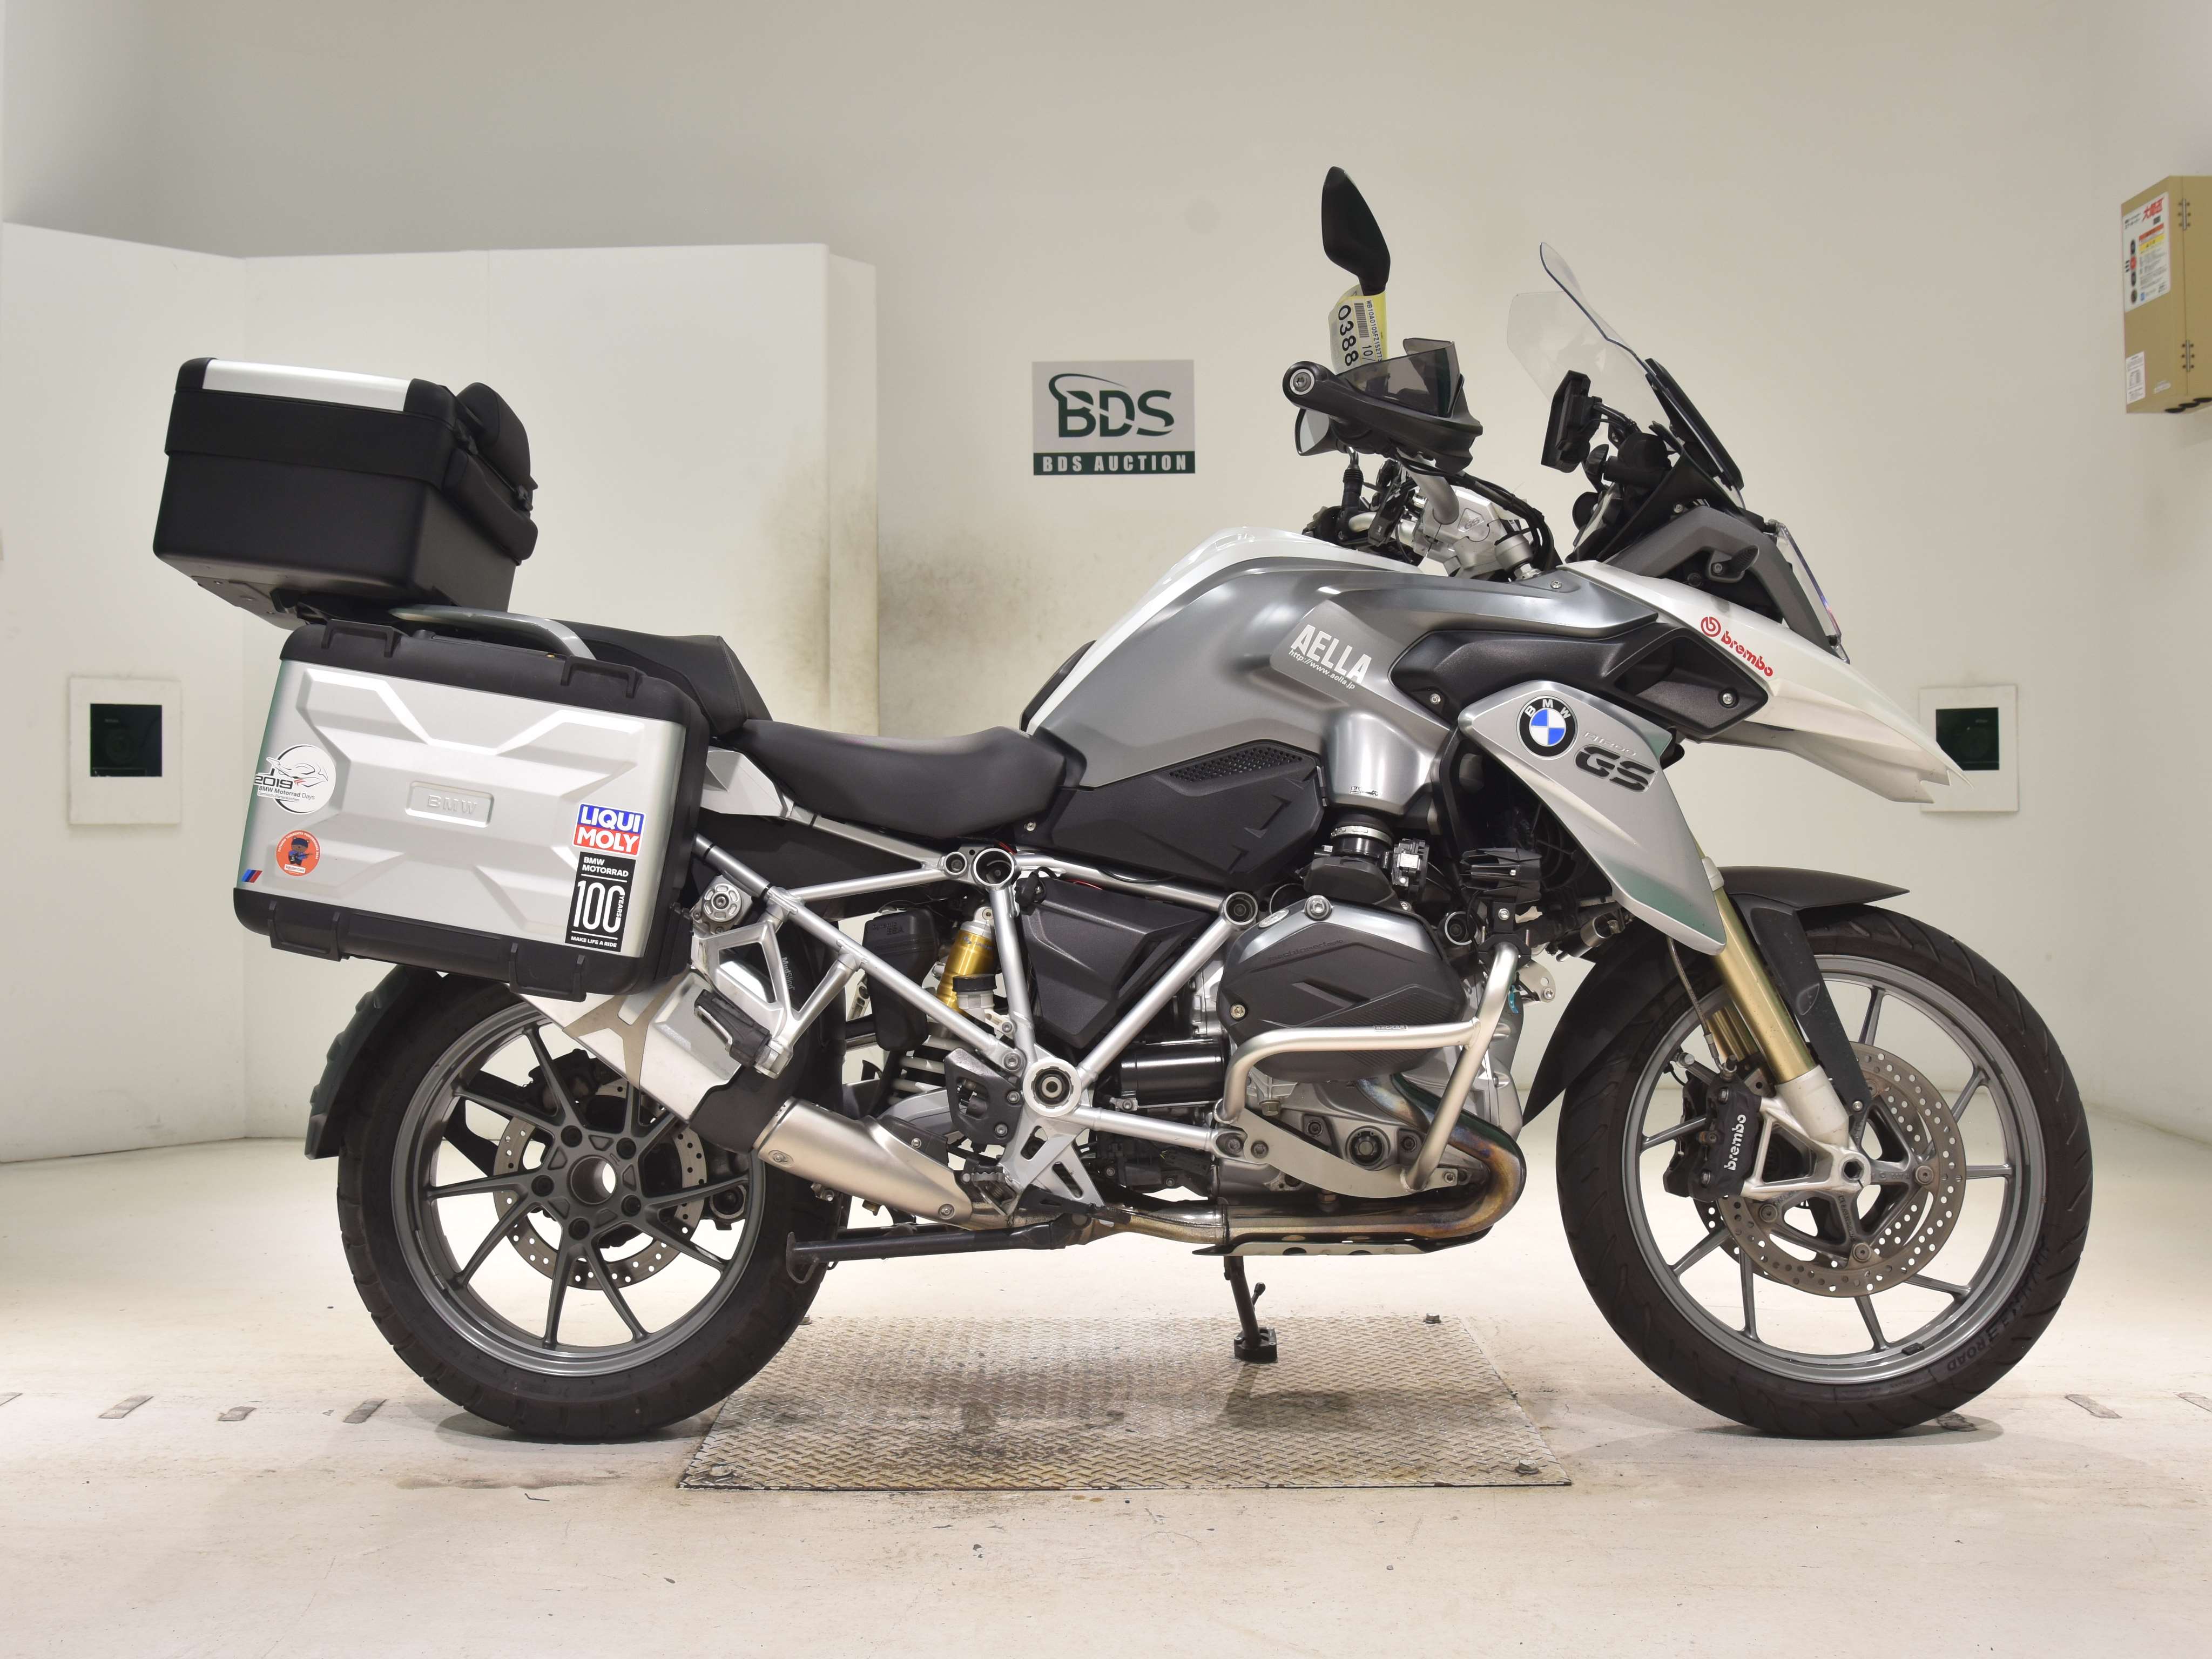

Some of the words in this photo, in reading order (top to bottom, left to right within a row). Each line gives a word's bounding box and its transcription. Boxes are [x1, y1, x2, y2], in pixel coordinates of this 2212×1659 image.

[1338, 305, 1359, 366] 0388
[1049, 373, 1175, 437] BDS
[1043, 456, 1082, 472] BDS
[1094, 455, 1186, 471] AUCTION
[1290, 624, 1372, 684] AELLA
[1721, 630, 1773, 677] brembo
[1289, 649, 1355, 690] http://www.aella.jp
[1525, 699, 1571, 719] BMW
[1574, 744, 1658, 792] GS
[254, 775, 293, 790] 2019
[274, 788, 301, 797] Motorrad
[301, 792, 315, 800] Days
[427, 794, 478, 814] BMW
[581, 806, 641, 833] LIQUI
[576, 826, 639, 853] MOLY
[582, 864, 629, 878] MOTORRAD
[583, 857, 605, 866] BMW
[573, 880, 625, 933] 100
[616, 895, 625, 918] YEARS
[571, 935, 587, 943] MAKE
[1723, 1114, 1746, 1171] brembo
[1947, 1338, 1992, 1372] ROAD
